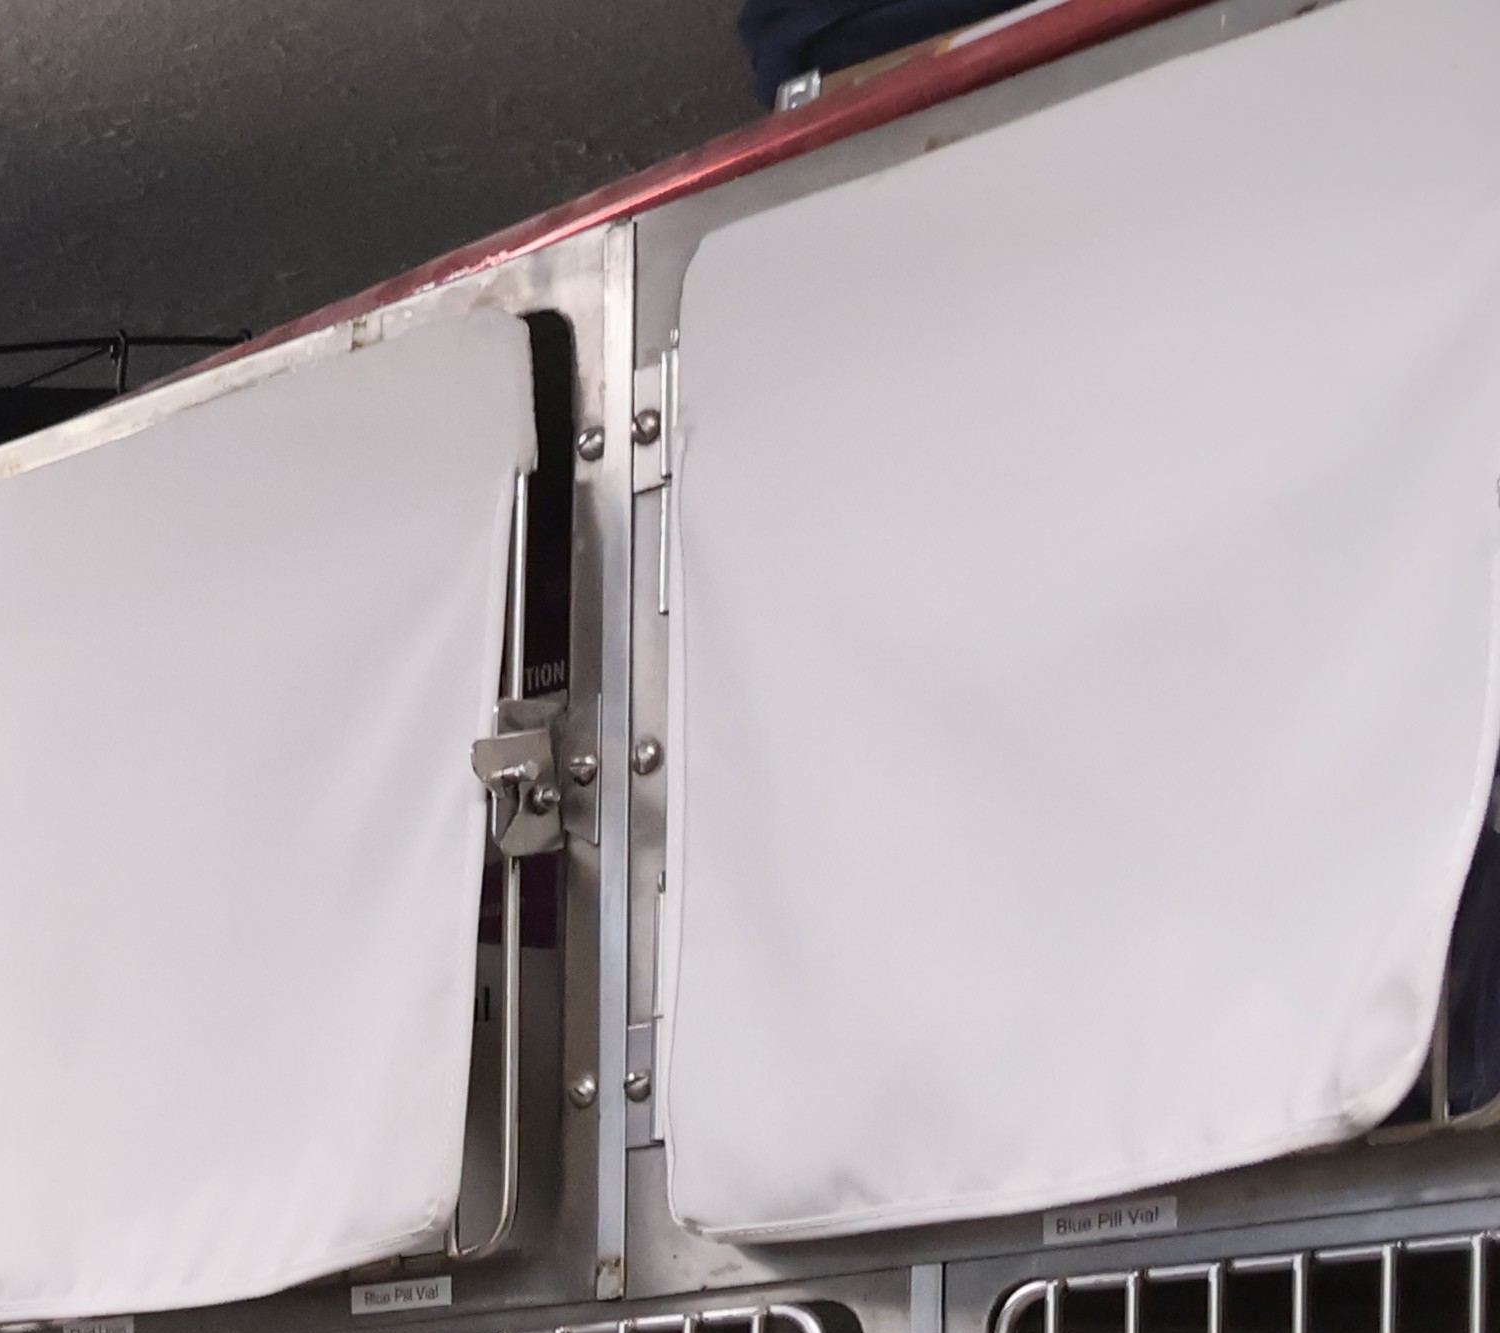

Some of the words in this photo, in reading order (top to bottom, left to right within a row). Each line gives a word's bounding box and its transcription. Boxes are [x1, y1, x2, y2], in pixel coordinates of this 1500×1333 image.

[524, 660, 564, 691] TION
[1055, 1217, 1093, 1235] Blue
[1097, 1210, 1123, 1230] Pill
[1128, 1205, 1160, 1226] Vial
